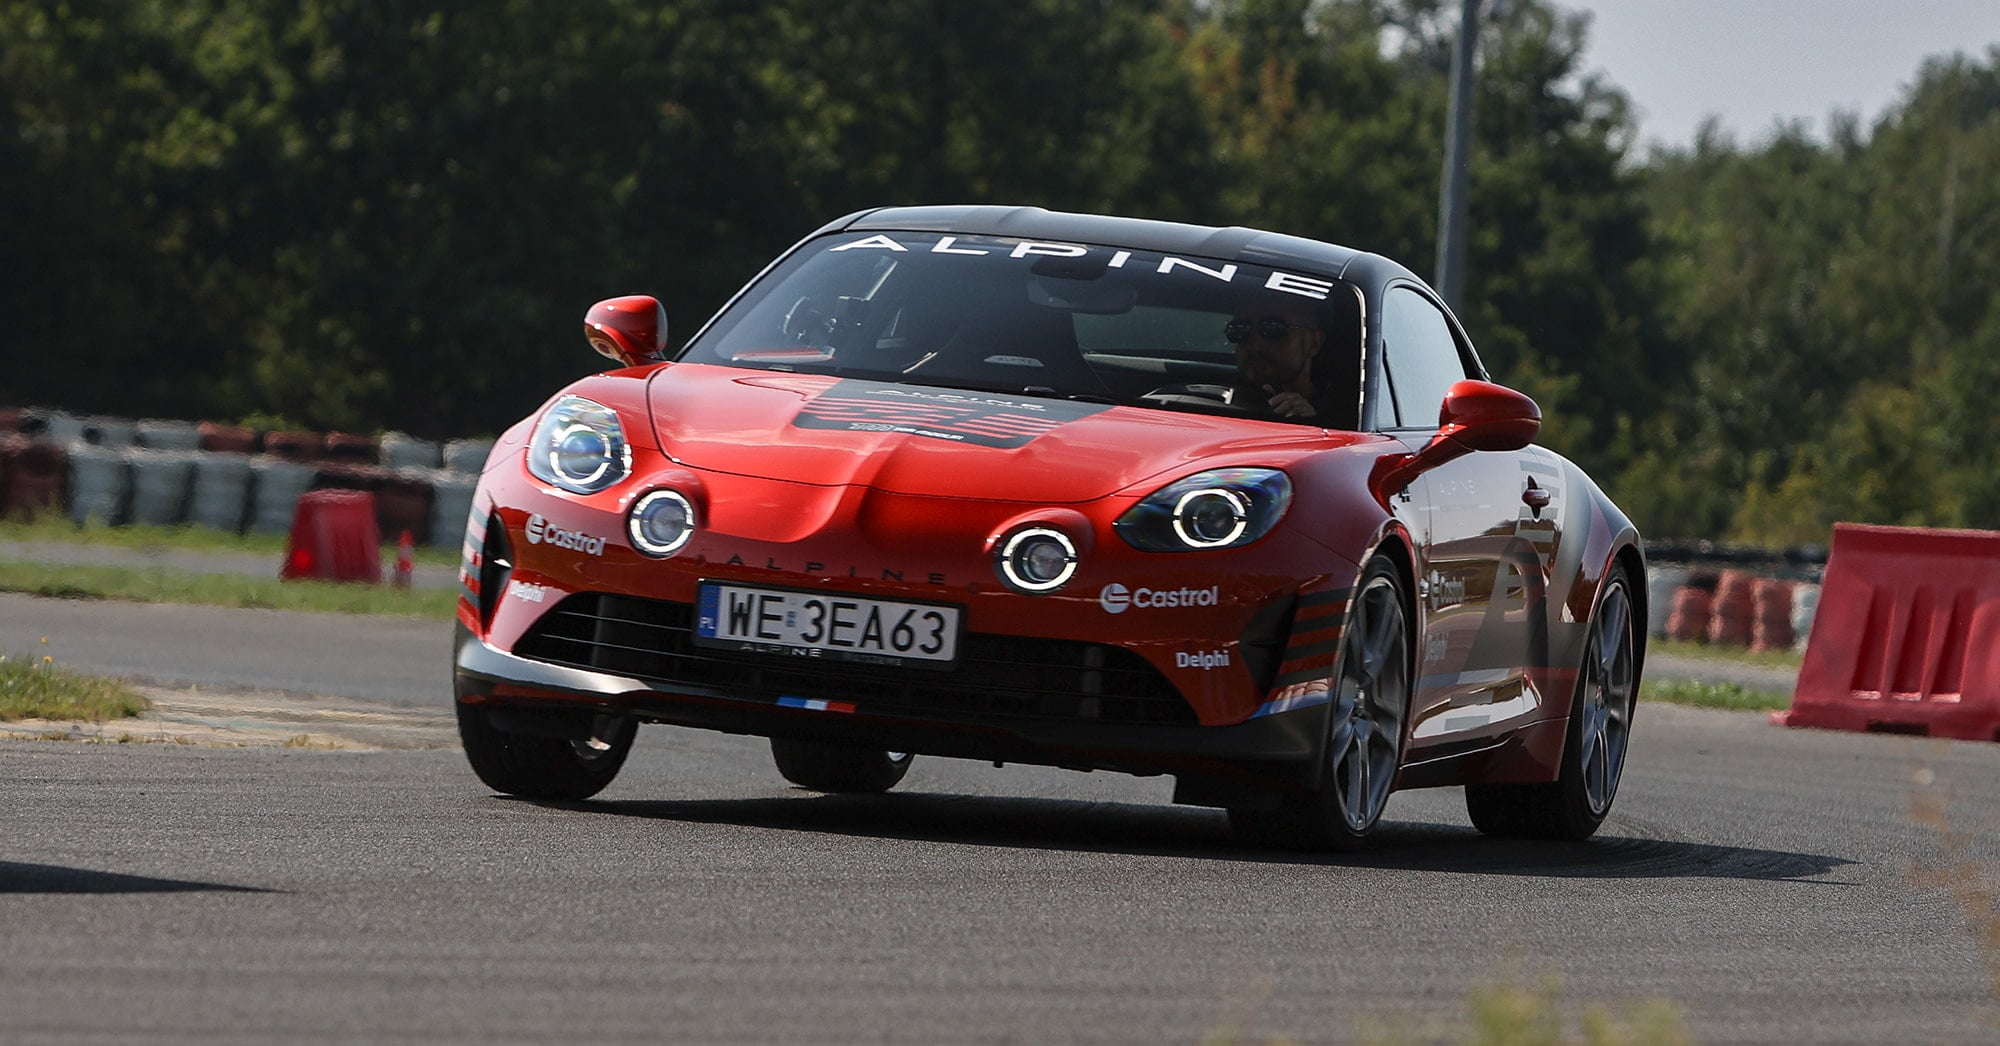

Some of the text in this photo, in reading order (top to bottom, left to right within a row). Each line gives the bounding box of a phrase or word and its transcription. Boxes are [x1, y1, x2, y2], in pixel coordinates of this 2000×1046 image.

[829, 233, 1334, 300] ALPINE
[543, 524, 605, 556] Castrol
[727, 553, 946, 584] ALPINE
[1133, 585, 1219, 608] Castrol
[699, 616, 715, 630] PL
[728, 591, 946, 654] WE 3EA63
[739, 643, 823, 659] ALPINE
[1175, 649, 1230, 671] Delphi
